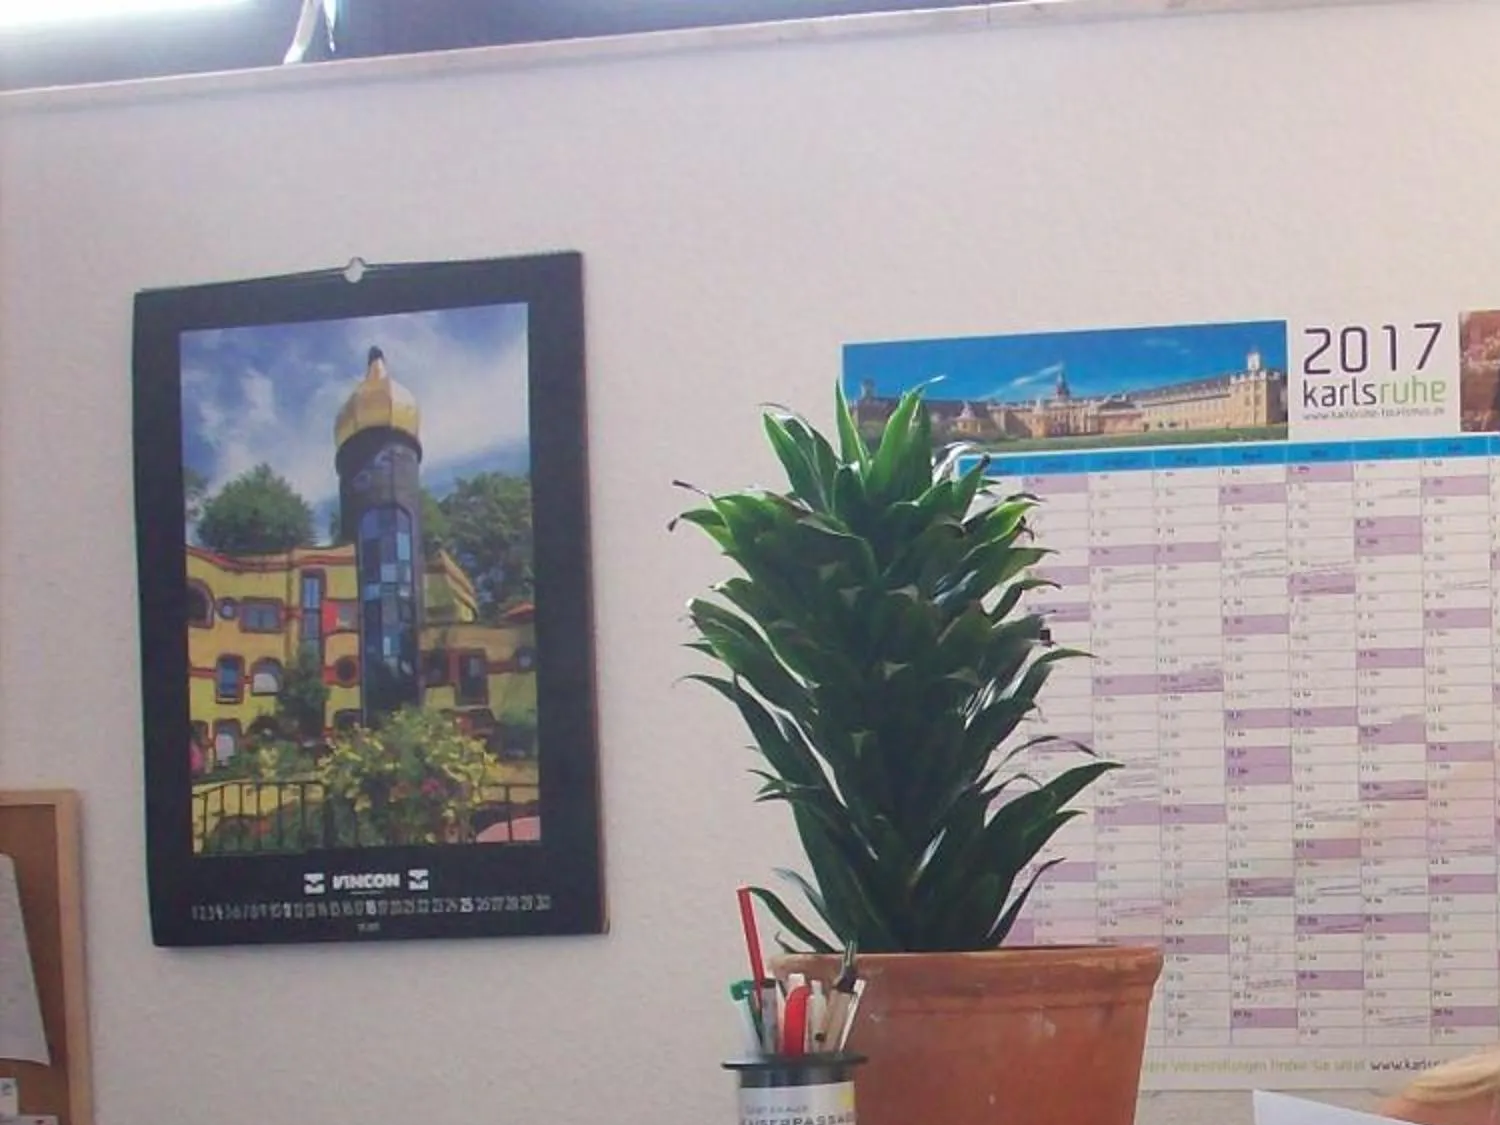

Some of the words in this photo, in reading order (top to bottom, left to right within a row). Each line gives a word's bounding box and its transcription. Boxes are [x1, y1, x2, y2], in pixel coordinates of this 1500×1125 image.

[1303, 322, 1442, 374] 2017
[1303, 376, 1447, 408] karlsruhe
[332, 873, 400, 890] VINCON
